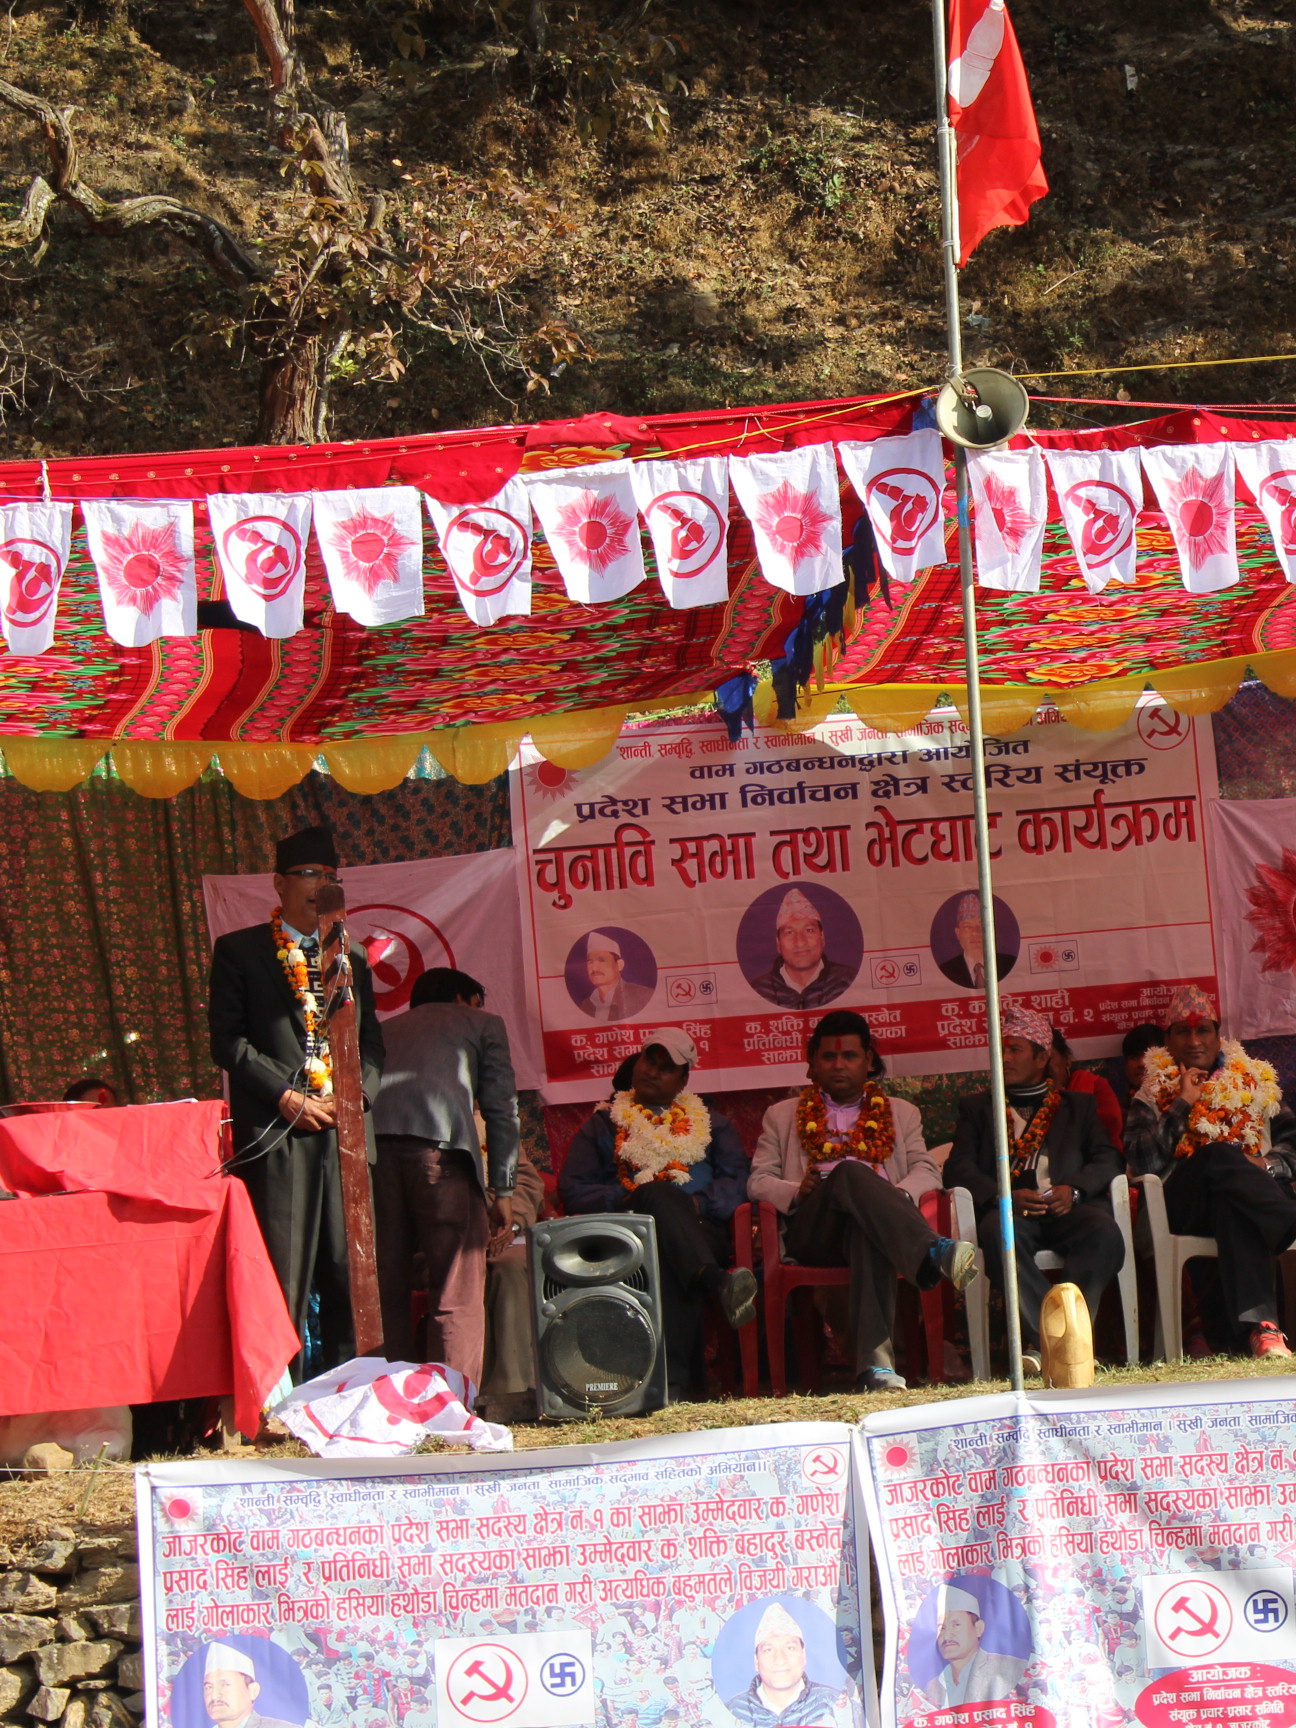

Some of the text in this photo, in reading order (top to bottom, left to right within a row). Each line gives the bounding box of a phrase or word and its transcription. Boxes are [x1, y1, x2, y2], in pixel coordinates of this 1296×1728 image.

[689, 763, 736, 780] वाम
[574, 795, 651, 823] प्रदेश
[662, 791, 729, 816] सभा
[740, 781, 861, 809] निर्वाचन
[870, 773, 930, 800] क्षेत्र
[532, 822, 656, 910] चुनावि
[669, 831, 756, 889] सभा
[769, 824, 852, 880] तथा
[1016, 788, 1197, 856] कार्यक्रम
[1031, 989, 1070, 1010] शाही
[769, 1015, 804, 1033] शक्ति
[936, 1016, 977, 1037] प्रदेश
[594, 1027, 635, 1045] गणेश
[743, 1032, 803, 1052] प्रतिनिधी
[573, 1046, 609, 1064] प्रदेश
[585, 1382, 618, 1391] PREMIERE
[161, 1523, 244, 1559] जाजरकोट
[250, 1529, 282, 1552] वाम
[287, 1524, 385, 1550] गठबन्धनका
[390, 1516, 430, 1547] प्रदेश
[435, 1518, 470, 1544] सभा
[475, 1512, 527, 1540] सदस्य
[533, 1505, 564, 1536] क्षेत्र
[593, 1509, 603, 1531] १
[610, 1505, 633, 1529] का
[638, 1500, 685, 1529] साझा
[796, 1486, 841, 1516] गणेश
[1188, 1665, 1251, 1682] आयोजक
[1152, 1691, 1177, 1706] प्रदेश
[1180, 1690, 1200, 1703] सभा
[1203, 1686, 1242, 1701] निर्वाचन
[1244, 1685, 1263, 1699] क्षेत्र
[935, 1711, 969, 1726] गणेश
[974, 1707, 1008, 1723] प्रसाद
[1010, 1703, 1036, 1718] सिंह
[1255, 1700, 1285, 1715] समिति
